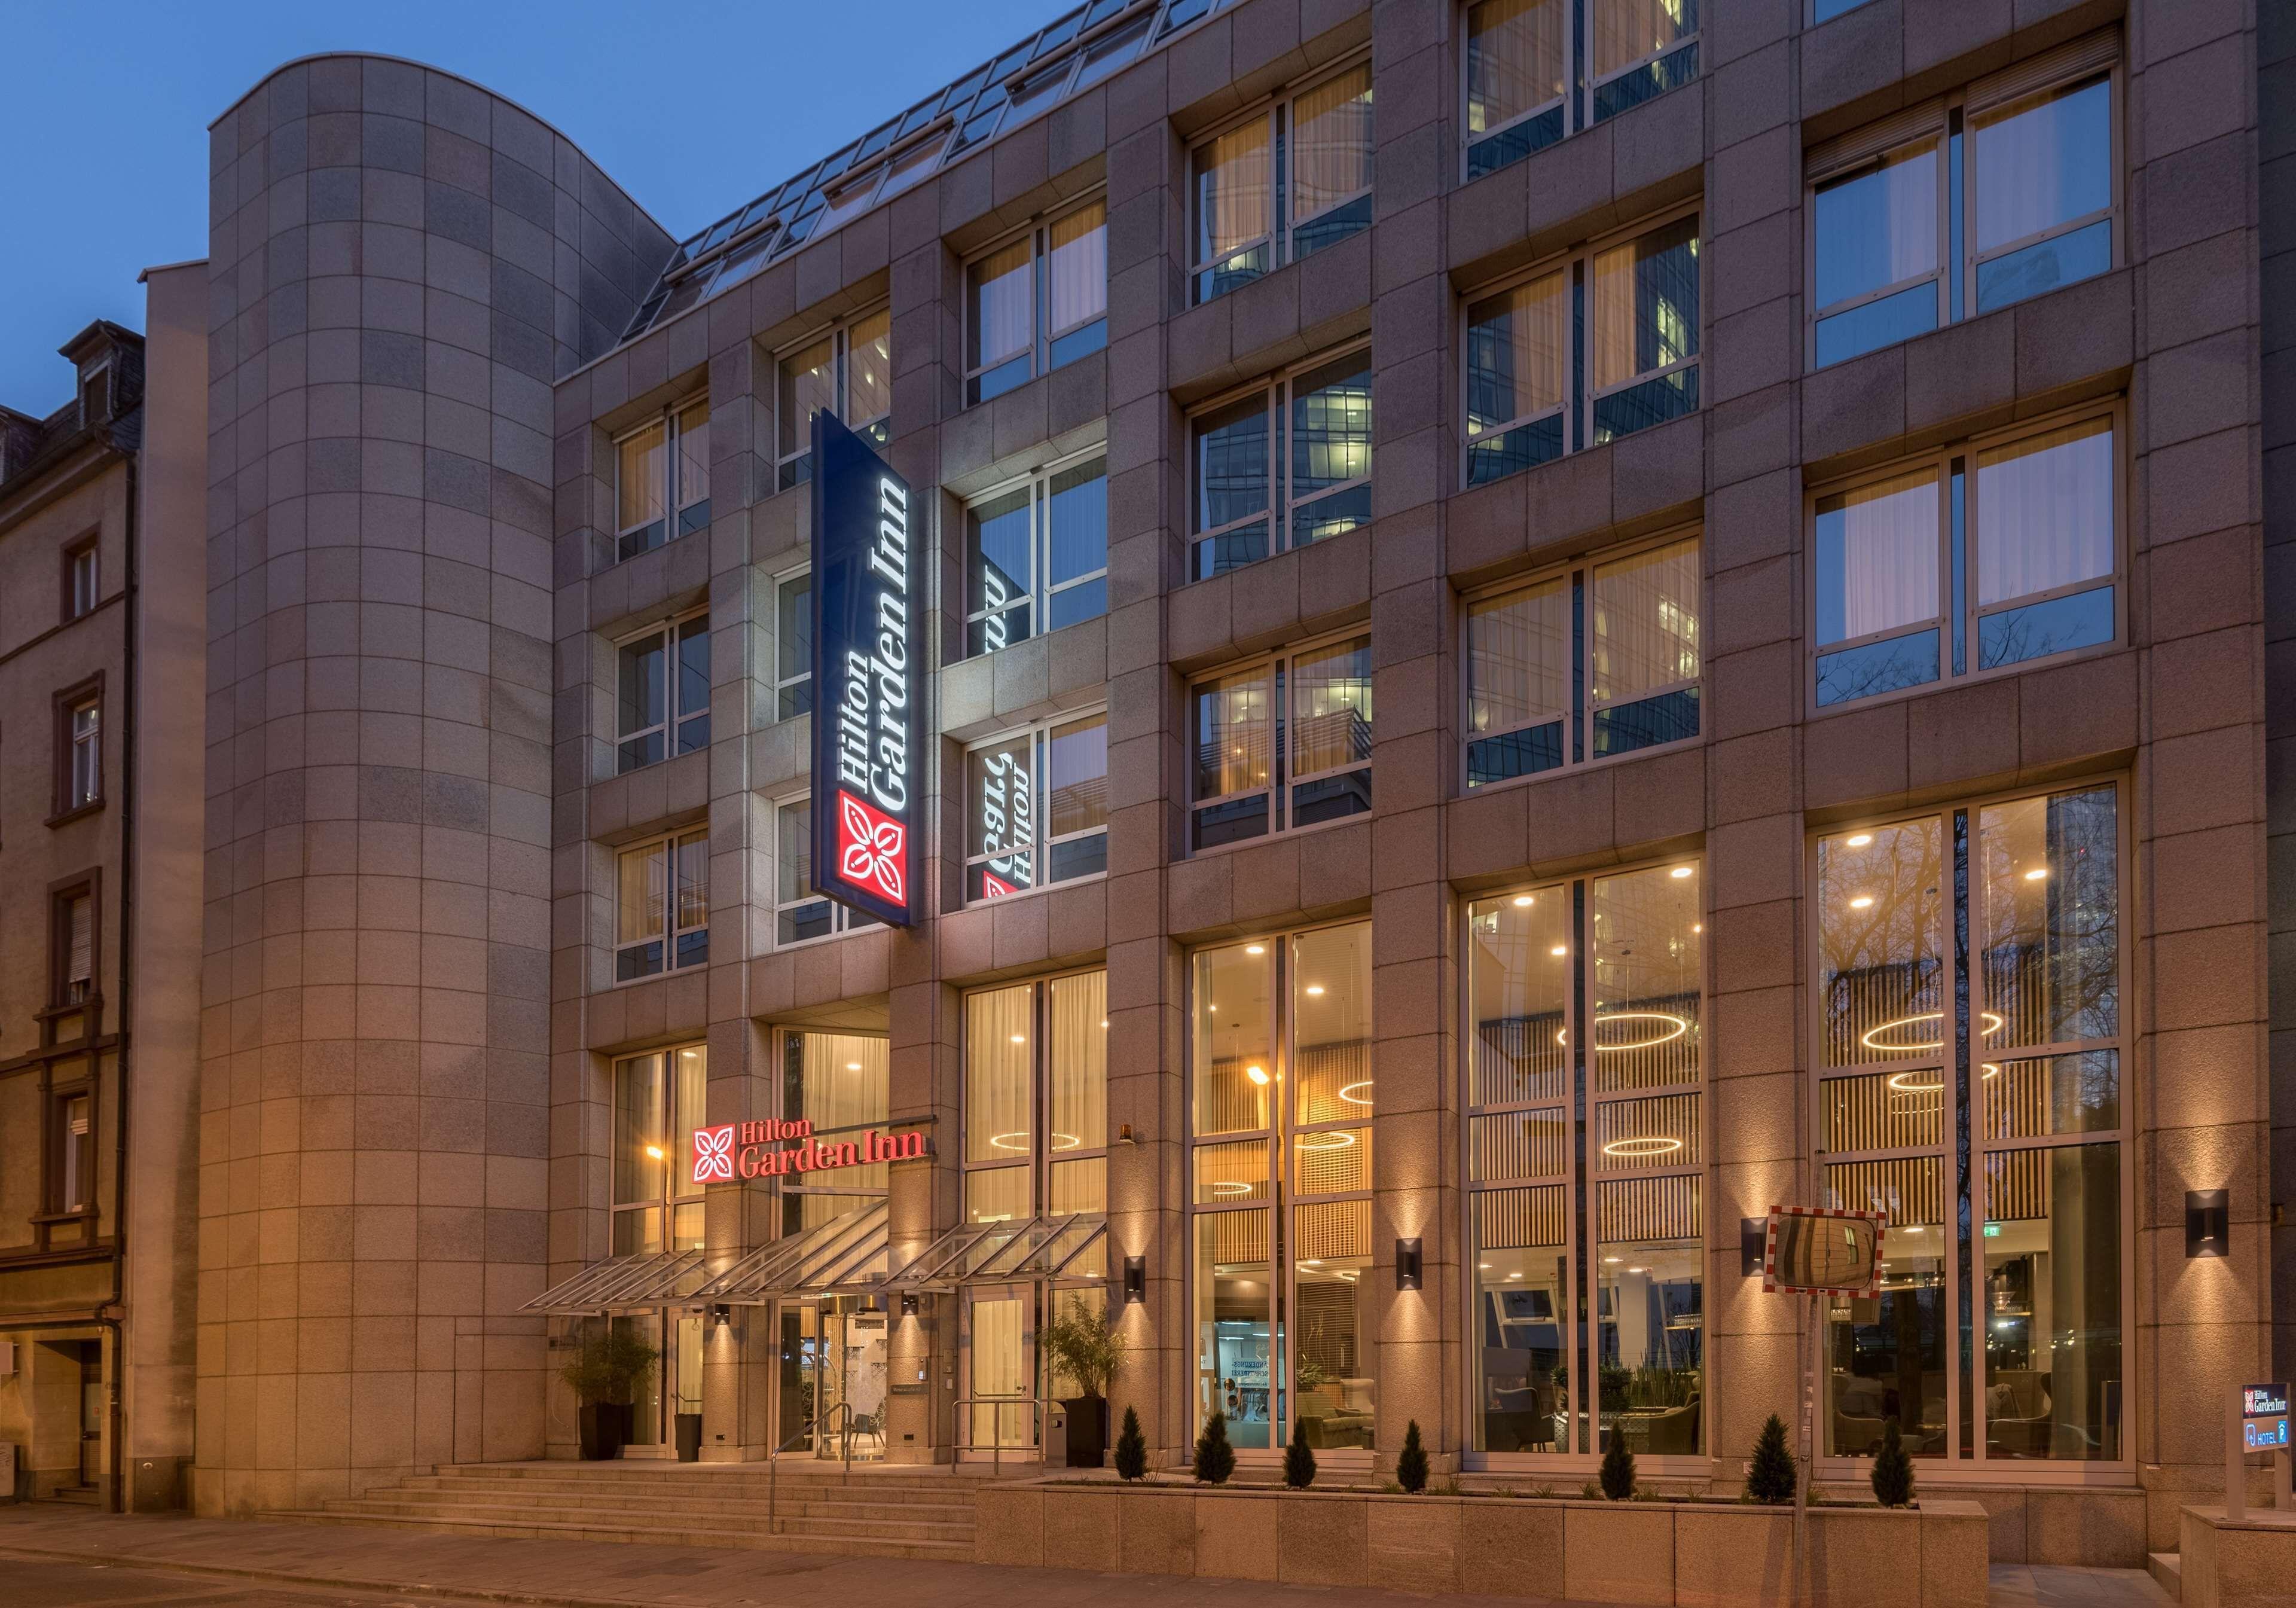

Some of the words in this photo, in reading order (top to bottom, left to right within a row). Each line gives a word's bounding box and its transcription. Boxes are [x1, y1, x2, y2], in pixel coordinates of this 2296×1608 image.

[871, 477, 906, 594] Inn
[871, 592, 906, 811] Garden
[840, 651, 869, 794] Hilton
[740, 1118, 811, 1145] Hilton
[739, 1138, 857, 1179] Garden
[863, 1130, 926, 1163] Inn
[2254, 1390, 2267, 1399] Hilton
[2254, 1399, 2274, 1412] Garden
[2274, 1398, 2286, 1411] Inn
[2257, 1432, 2276, 1445] HOTEL
[2280, 1428, 2284, 1439] P
